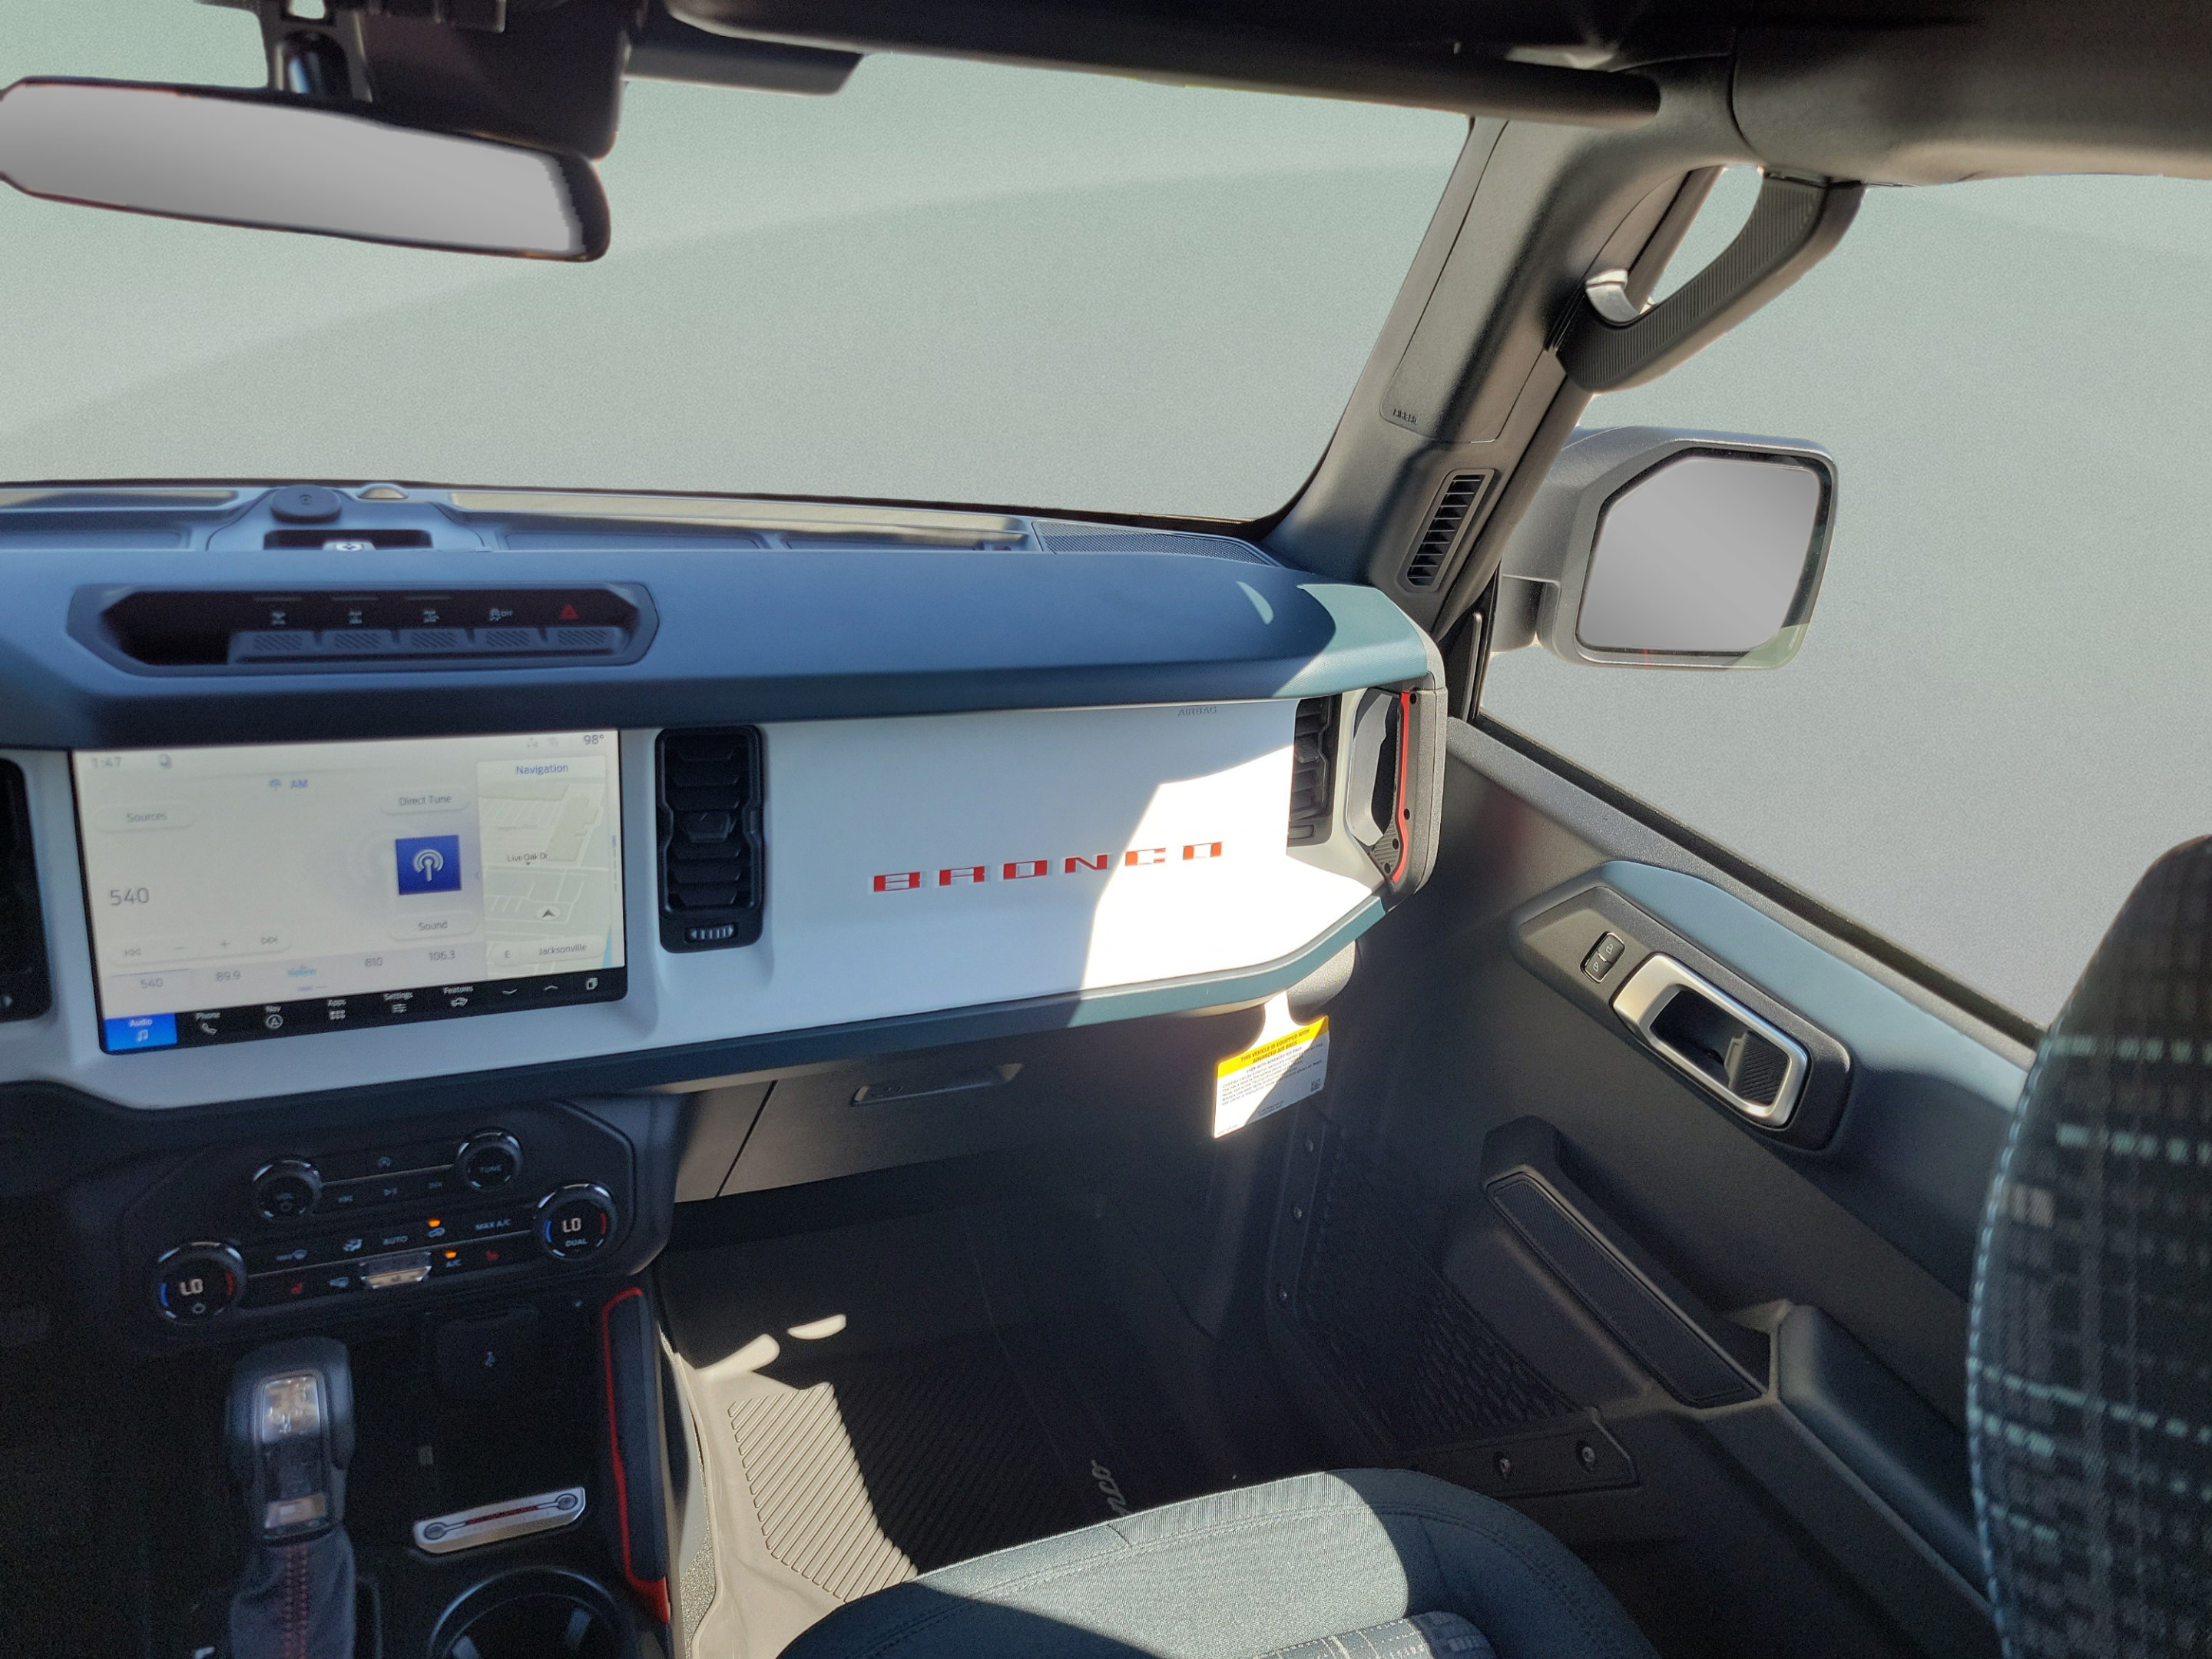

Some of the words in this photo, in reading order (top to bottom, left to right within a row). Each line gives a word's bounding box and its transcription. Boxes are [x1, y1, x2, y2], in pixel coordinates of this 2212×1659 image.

[1177, 707, 1217, 717] AIRBAG
[515, 763, 569, 776] Navigation
[290, 779, 309, 789] AM
[399, 795, 426, 806] Direct
[428, 793, 452, 805] Tune
[127, 810, 168, 824] Sources
[523, 853, 538, 861] Oak
[870, 840, 1224, 893] BRONCO
[109, 887, 151, 906] 540
[418, 919, 449, 932] Sound
[429, 949, 456, 962] 106.3
[504, 950, 511, 959] E
[539, 942, 587, 956] Jacksonville
[140, 977, 164, 989] 540
[215, 970, 241, 982] 89.9
[384, 991, 414, 1002] Settings
[442, 985, 474, 995] Features
[265, 1005, 282, 1014] Nav
[326, 998, 347, 1009] Apps
[195, 1010, 221, 1021] Phone
[128, 1018, 153, 1028] Audio
[1240, 1054, 1251, 1062] THIS
[1252, 1046, 1270, 1058] VEHICLE
[1276, 1034, 1298, 1048] EQUIPPED
[1298, 1028, 1310, 1038] WITH
[1252, 1049, 1277, 1064] ADVANCED
[1277, 1045, 1285, 1054] AIR
[1285, 1040, 1298, 1051] BAGS
[475, 1221, 495, 1231] MAX
[496, 1218, 512, 1228] A/C
[382, 1235, 409, 1246] AUTO
[565, 1238, 588, 1247] DUAL
